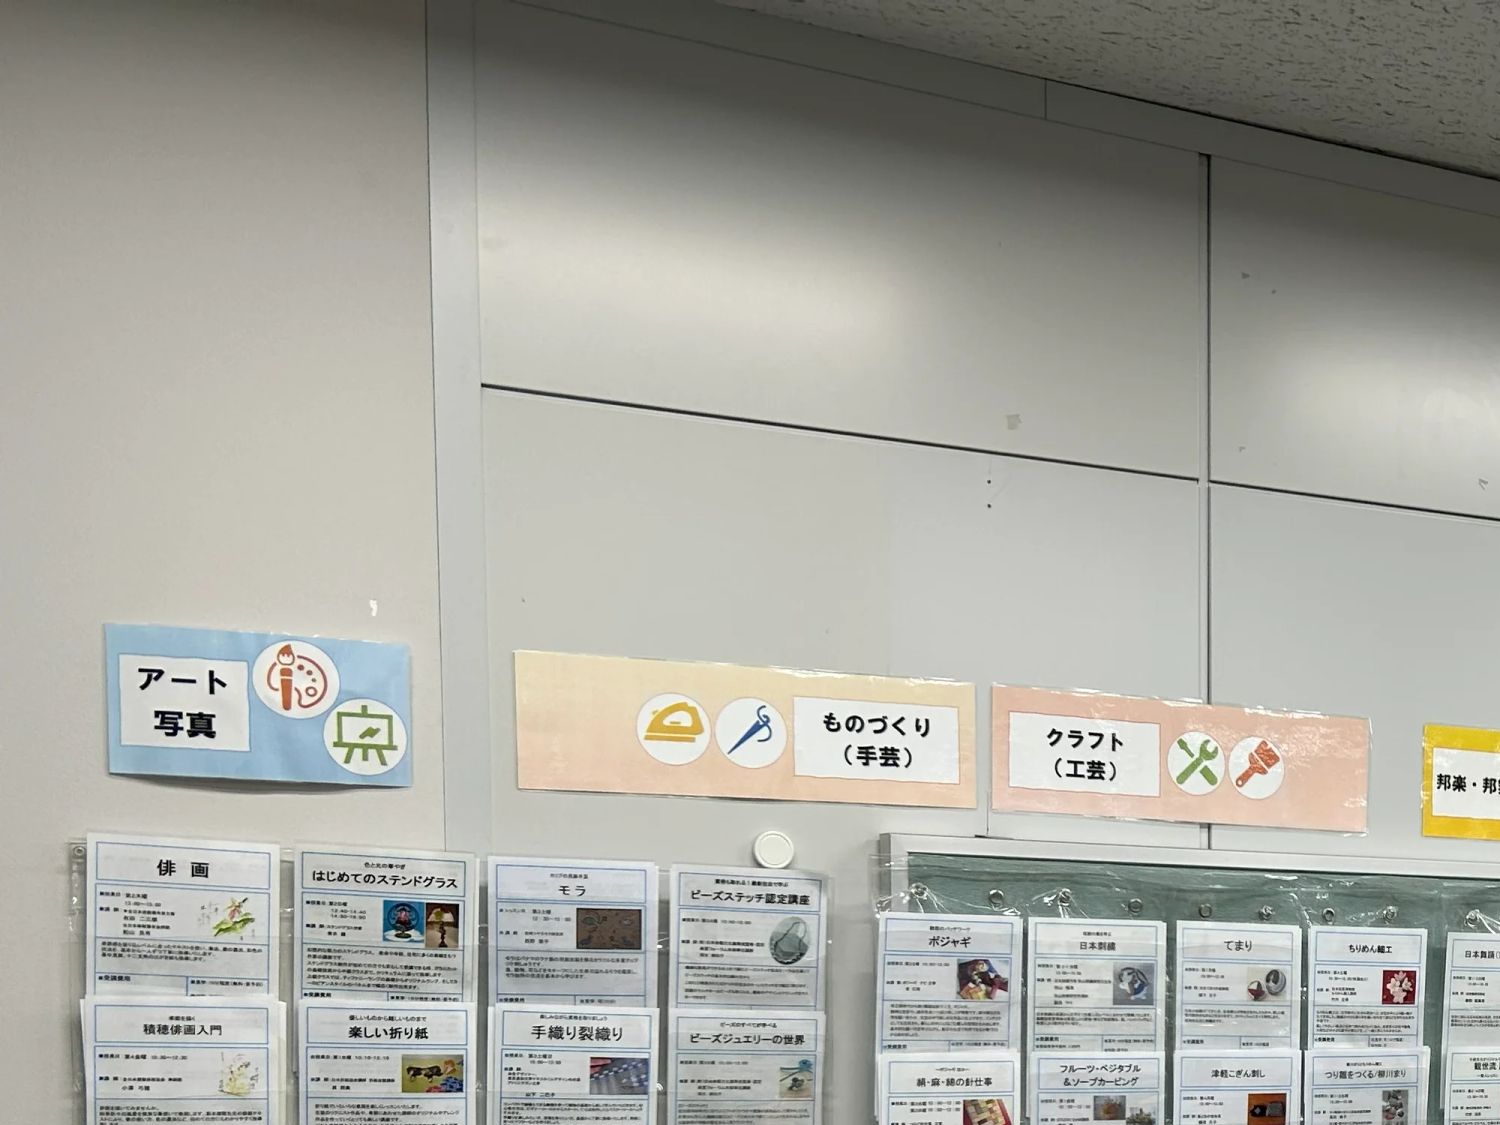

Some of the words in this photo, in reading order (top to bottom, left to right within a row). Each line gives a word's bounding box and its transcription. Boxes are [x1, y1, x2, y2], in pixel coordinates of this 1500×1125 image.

[137, 667, 228, 695] アート
[153, 710, 217, 740] 写真
[823, 712, 931, 738] ものづくり
[1046, 728, 1124, 753] クラフト
[843, 744, 913, 769] （手芸）
[1054, 757, 1117, 782] （工芸）
[157, 859, 210, 878] 俳画
[312, 870, 458, 888] はじめてのステンドグラス
[558, 885, 586, 896] モラ
[691, 889, 810, 905] ビーズステッチ認定講座
[1224, 940, 1252, 951] てまり
[143, 1023, 223, 1036] 積穂俳画入門
[348, 1027, 429, 1039] 楽しい折り紙
[531, 1025, 623, 1042] 手織り裂織り
[690, 1034, 805, 1045] ビーズジュエリーの世界
[1060, 1064, 1141, 1073] フルーツ・ベジタブル
